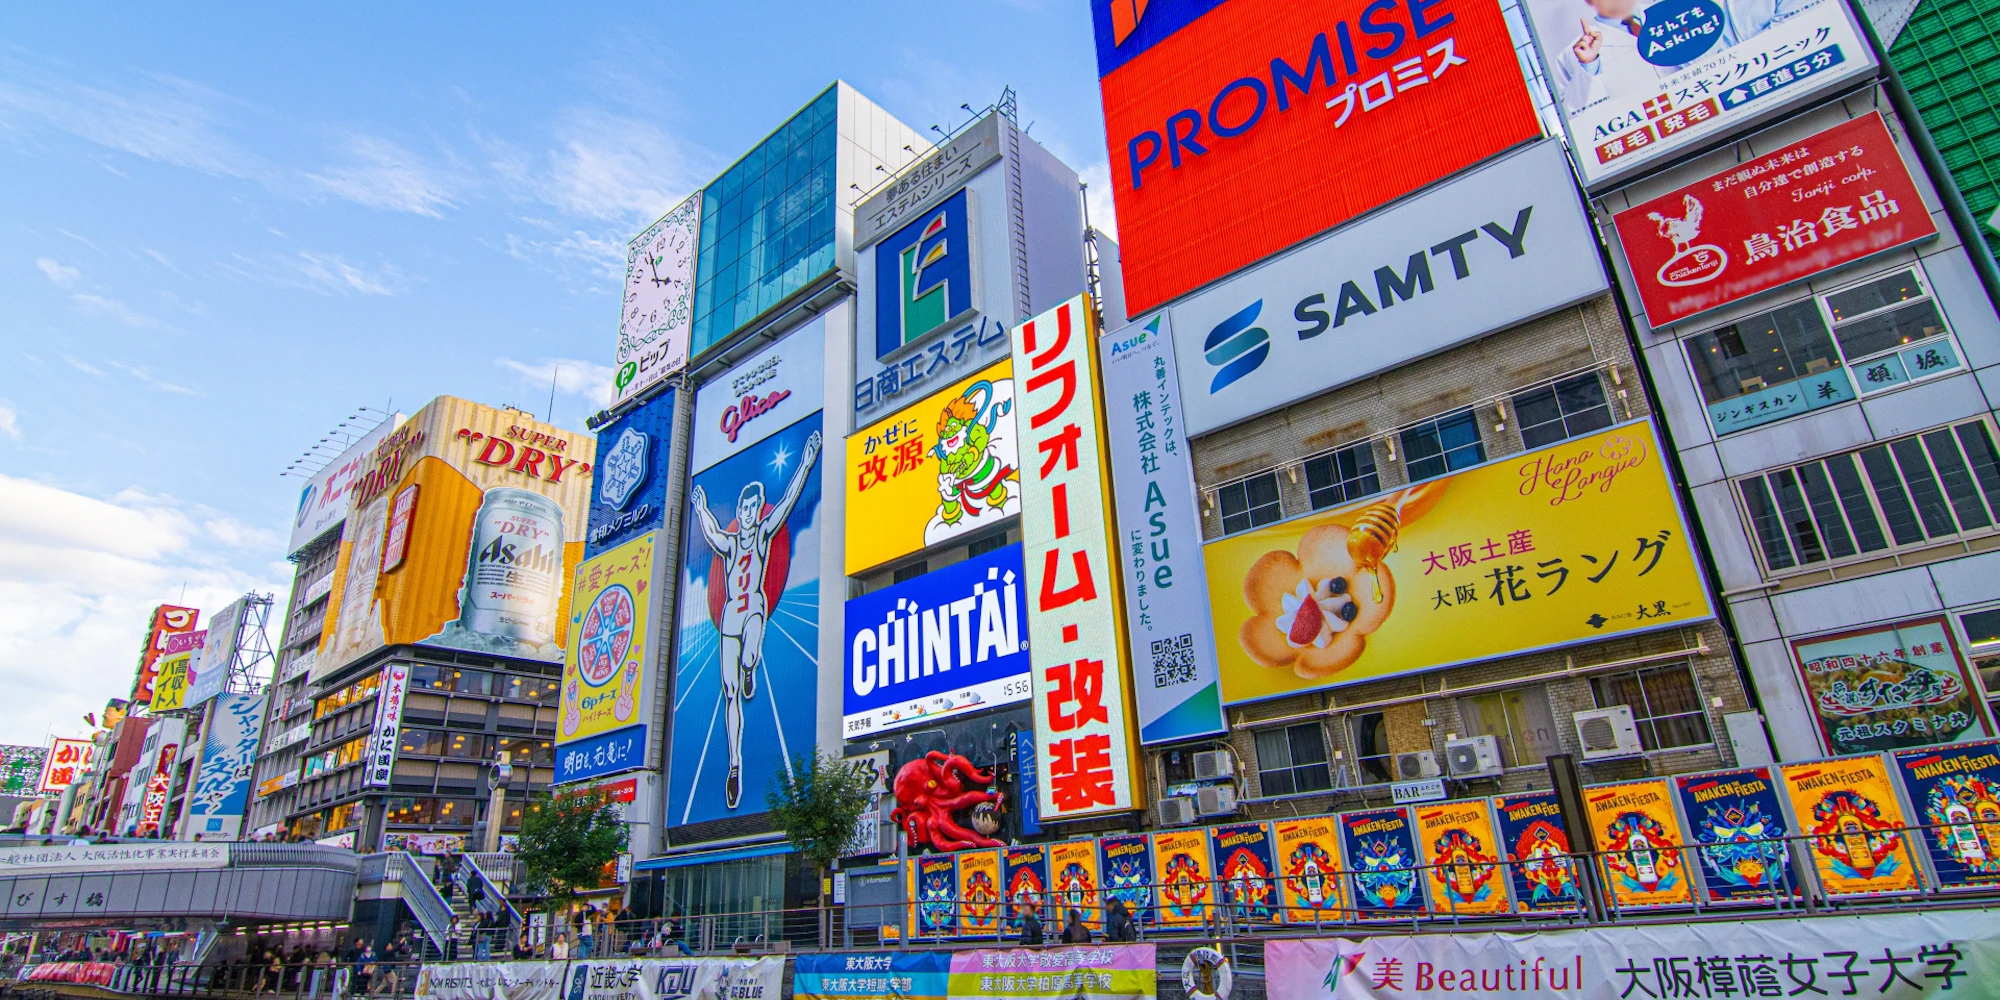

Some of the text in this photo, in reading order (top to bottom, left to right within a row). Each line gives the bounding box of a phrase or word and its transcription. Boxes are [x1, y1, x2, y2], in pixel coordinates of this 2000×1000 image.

[1647, 14, 1721, 58] Asking!
[1649, 6, 1705, 38] なんでも
[1325, 37, 1469, 129] プロミス
[1593, 110, 1644, 142] AGA
[1674, 26, 1831, 105] スキンクリニック
[1749, 51, 1833, 95] 直進5分
[1127, 0, 1455, 190] PROMISE
[1664, 103, 1711, 133] 発毛
[1603, 130, 1649, 159] 薄毛
[874, 154, 974, 231] エステムシリーズ
[885, 146, 958, 204] 夢ある住まい
[1744, 189, 1900, 266] 鳥治食品
[1293, 204, 1534, 341] SAMTY
[639, 338, 671, 373] ピップ
[854, 315, 1005, 413] 日商エステム
[1111, 332, 1147, 357] Asue
[1152, 355, 1179, 457] 丸善インテックは、
[1716, 393, 1799, 423] ジンギスカン
[507, 424, 568, 452] SUPER
[863, 418, 919, 456] かぜに
[857, 432, 925, 493] 改源
[1131, 390, 1174, 589] 株式会社 Asue
[590, 503, 649, 544] 雪印メグミルク
[479, 535, 554, 575] Asahi
[1022, 303, 1117, 812] リフォーム・改装
[1421, 529, 1537, 576] 大阪土産
[1430, 530, 1672, 611] 大阪 花ラング
[736, 549, 753, 614] グリコ
[1130, 529, 1153, 632] に変わりました。
[852, 568, 1020, 697] CHINTAI
[1807, 640, 1947, 674] 昭和四十六年創業
[1796, 770, 1840, 793] AWAKEN
[1839, 768, 1875, 786] FIESTA
[1913, 757, 1962, 781] AWAKEN
[1961, 754, 2000, 773] FIESTA
[1393, 786, 1420, 799] BAR
[1595, 793, 1632, 814] AWAKEN
[1631, 791, 1661, 808] FIESTA
[1693, 783, 1736, 804] AWAKEN
[1734, 779, 1767, 798] FIESTA
[1352, 822, 1382, 837] AWAKEN
[1382, 818, 1405, 833] FIESTA
[1425, 813, 1456, 830] AWAKEN
[1456, 810, 1481, 825] FIESTA
[1508, 804, 1542, 822] AWAKEN
[1542, 803, 1561, 817] FIES
[1282, 825, 1329, 843] AWAKEN FIESTA
[982, 949, 1115, 968] 東大阪大学敬愛高等学校
[1371, 942, 1967, 1000] 美 Beautiful 大阪樟蔭女子大学
